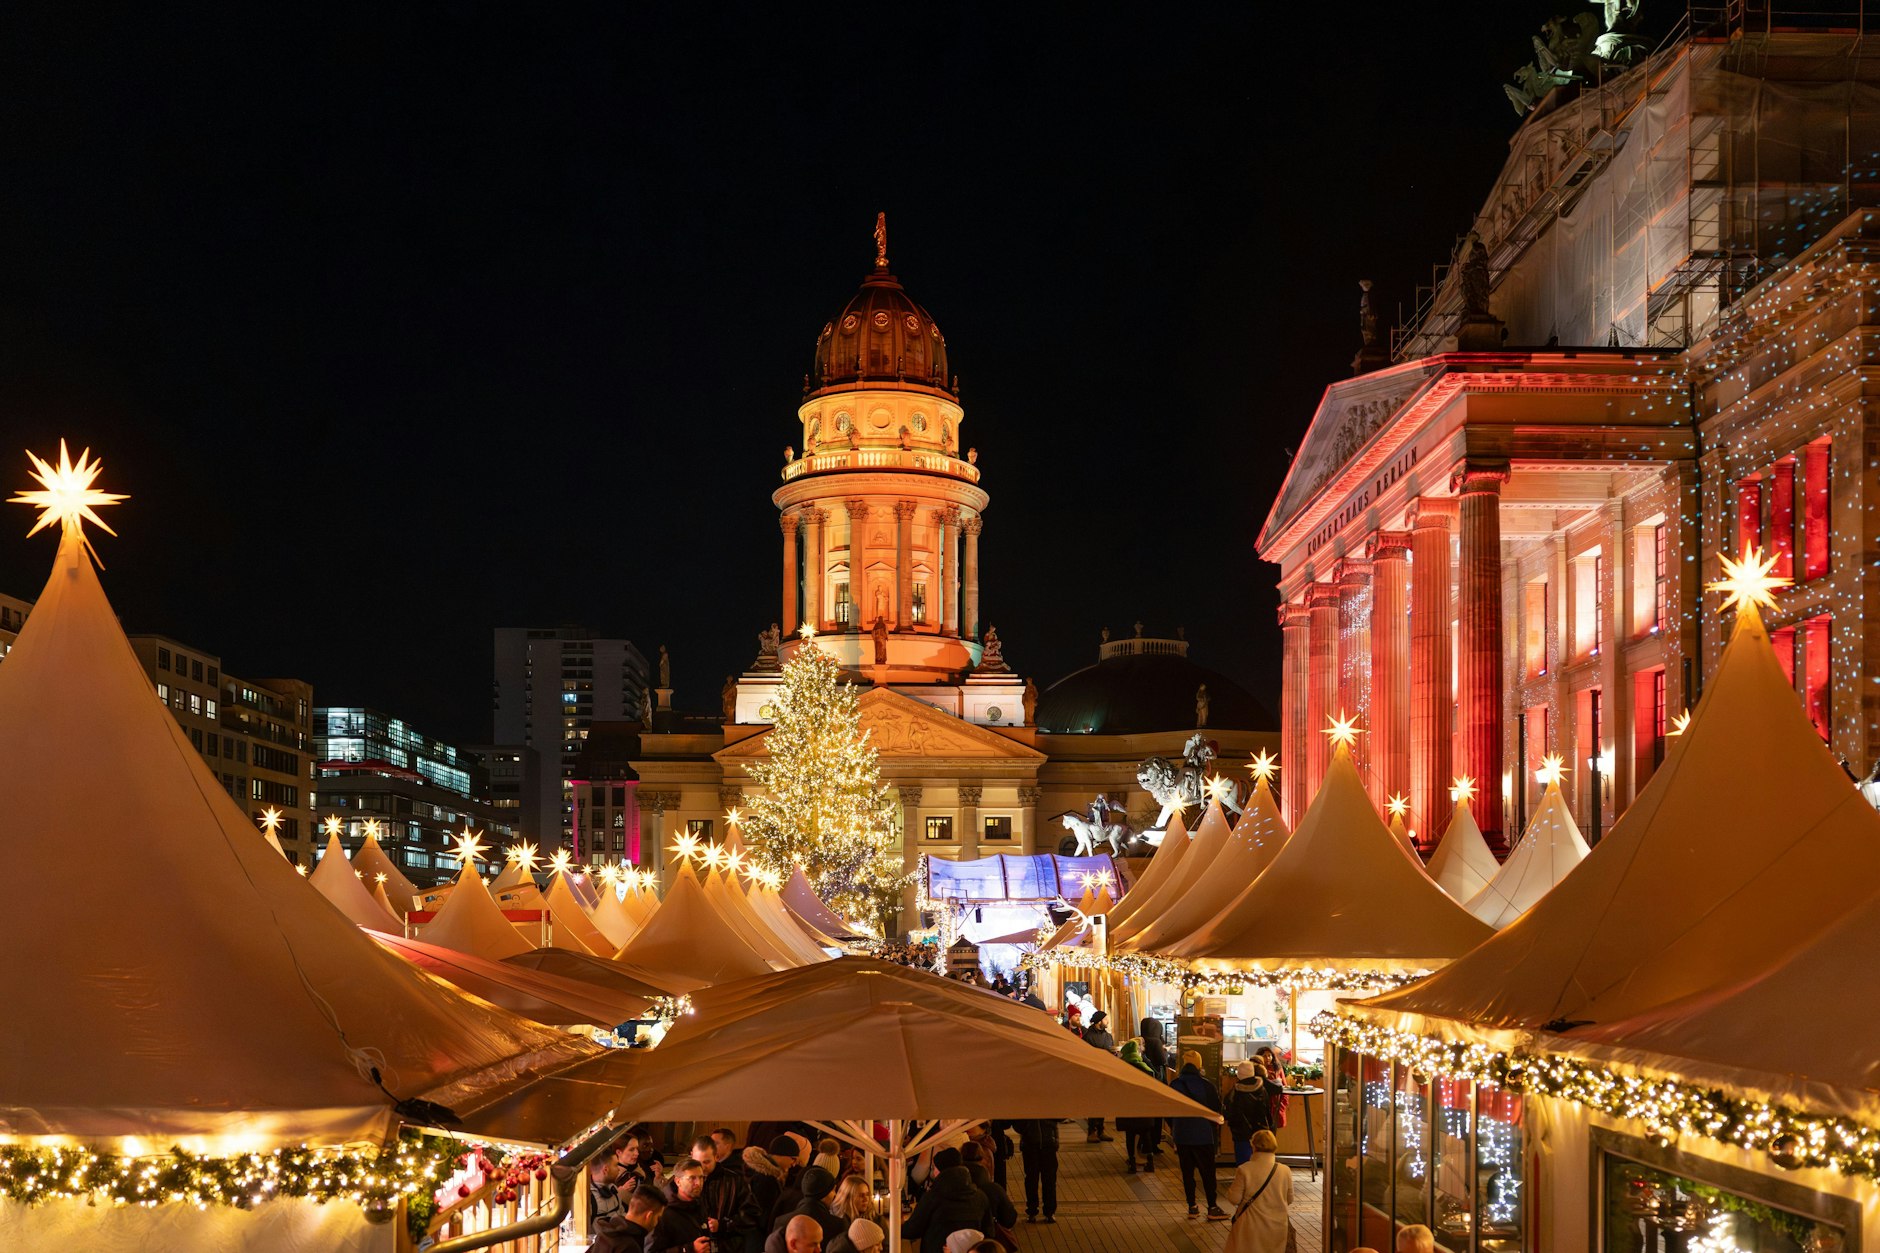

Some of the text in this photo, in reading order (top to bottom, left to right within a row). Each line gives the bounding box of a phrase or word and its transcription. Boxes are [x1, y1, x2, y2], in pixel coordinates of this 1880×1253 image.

[1307, 446, 1417, 557] KONZERTHAUS BERLIN
[578, 798, 586, 857] HILTON
